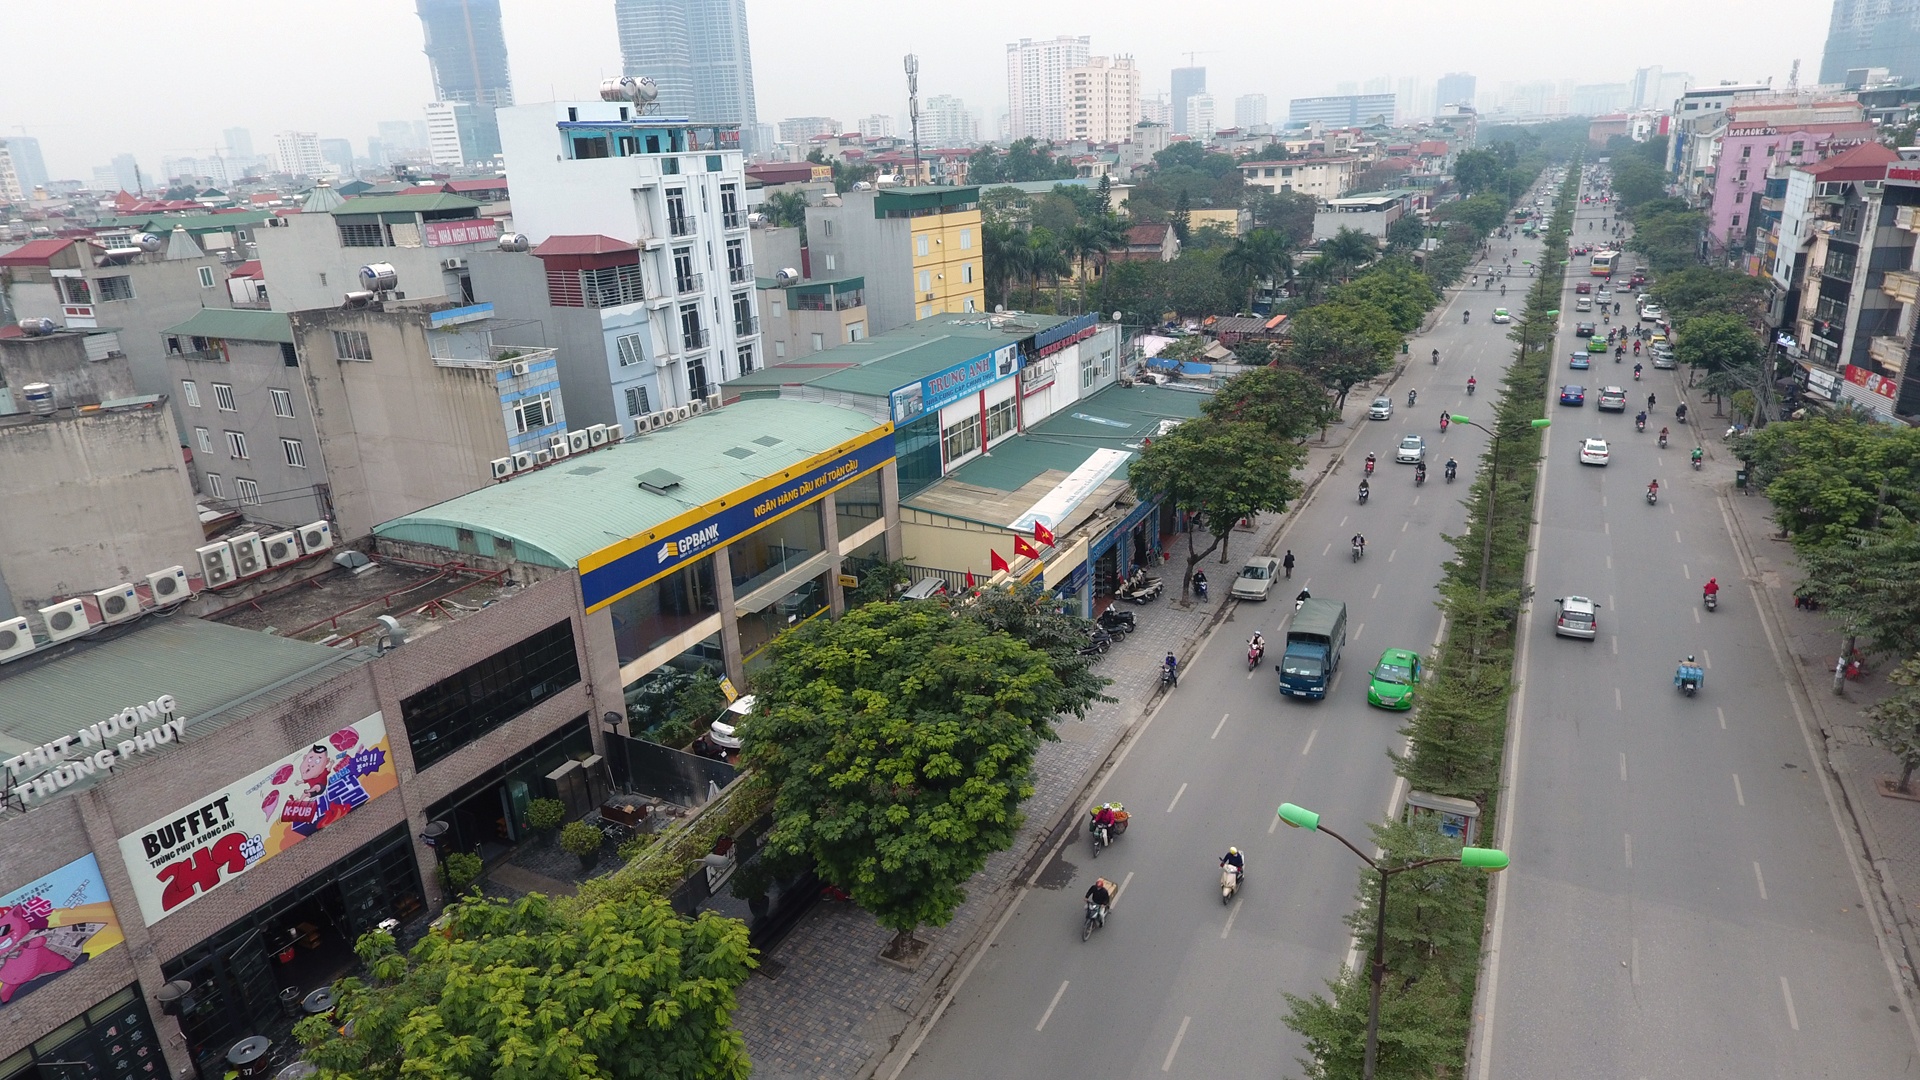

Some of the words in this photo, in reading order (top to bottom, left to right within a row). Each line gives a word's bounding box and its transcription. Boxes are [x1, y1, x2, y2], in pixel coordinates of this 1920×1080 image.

[1730, 128, 1765, 136] KARAOKE
[1766, 127, 1777, 135] 70
[928, 367, 966, 395] TRUNG
[968, 357, 990, 378] ANH
[753, 499, 777, 518] NGÂN
[777, 488, 799, 507] HÀNG
[799, 481, 814, 496] DẦU
[814, 474, 828, 488] KHÍ
[827, 466, 845, 482] TOÀN
[845, 459, 859, 474] CẦU
[678, 523, 720, 553] GPBANK
[78, 694, 177, 748] NƯỚNG
[13, 749, 117, 803] THÙNG
[117, 716, 187, 760] PHUY
[141, 795, 230, 859] BUFFET
[283, 805, 313, 818] K-PUB
[149, 852, 176, 869] THÙNG
[176, 840, 195, 856] PHUY
[156, 832, 249, 912] 249
[243, 1068, 253, 1076] 37
